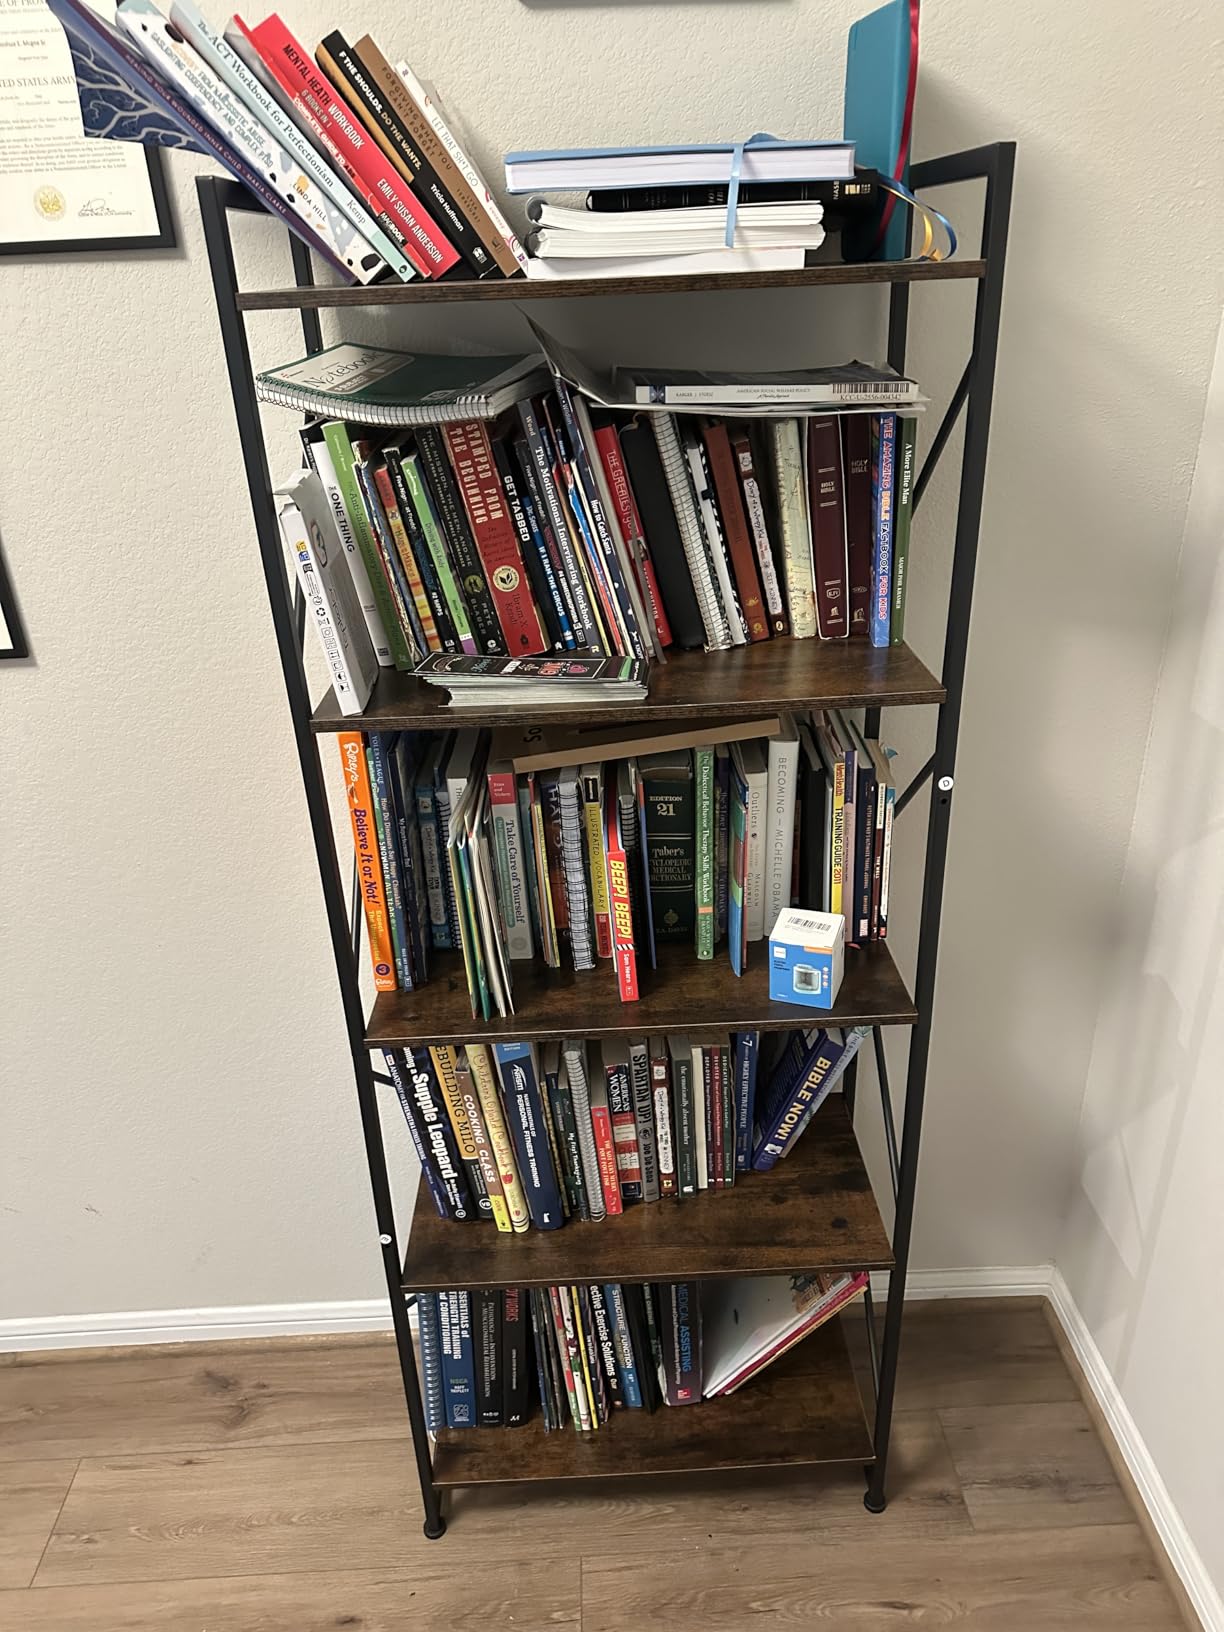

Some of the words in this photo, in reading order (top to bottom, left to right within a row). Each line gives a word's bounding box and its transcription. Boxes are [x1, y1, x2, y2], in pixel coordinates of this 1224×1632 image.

[148, 31, 188, 71] GASLIGHTING
[181, 68, 225, 113] CODEPENDENCY
[222, 112, 236, 126] AND
[232, 123, 261, 152] COMPLEX
[196, 19, 212, 36] The
[206, 32, 234, 62] ACT
[228, 59, 275, 111] Workbook
[268, 108, 286, 127] for
[280, 123, 337, 187] Perfectionism
[280, 43, 313, 80] MENTAL
[305, 76, 333, 106] HEATH
[325, 102, 366, 150] WORKBOOK
[341, 56, 358, 76] THE
[351, 72, 385, 114] SHOULDS.
[378, 110, 392, 126] DO
[387, 123, 404, 142] THE
[397, 139, 424, 171] WANTS.
[379, 65, 420, 121] FORGIVING
[417, 122, 438, 149] WHAT
[436, 150, 453, 171] YOU
[387, 89, 410, 119] CAN'T
[407, 120, 435, 157] FORGET
[170, 99, 204, 133] WOUNDED
[202, 131, 223, 152] INNER
[222, 150, 242, 170] CHILD
[245, 172, 265, 193] MARIA
[264, 191, 287, 215] CLARKE
[430, 116, 445, 133] LET
[440, 130, 458, 152] THAT
[465, 171, 479, 187] GO
[290, 182, 315, 206] LINDA
[310, 204, 329, 222] HILL
[343, 199, 369, 225] Kemp
[375, 178, 399, 204] EMILY
[392, 199, 418, 227] SUSAN
[410, 223, 445, 263] ANDERSON
[428, 183, 446, 204] Tricia
[440, 201, 466, 232] Huffman
[302, 350, 384, 388] Notebook
[883, 416, 893, 438] THE
[448, 426, 467, 453] THE
[458, 459, 488, 524] BEGINNING
[463, 422, 491, 480] STAMPED
[483, 487, 504, 520] FROM
[881, 441, 892, 488] AMAZING
[902, 470, 910, 487] Elite
[425, 430, 436, 449] THE
[431, 449, 449, 491] MISSION,
[445, 493, 455, 512] THE
[450, 511, 462, 533] MEN,
[458, 534, 469, 554] AND
[464, 554, 473, 567] ME
[501, 474, 518, 498] GET
[329, 492, 344, 517] ONE
[337, 518, 356, 553] THING
[508, 498, 533, 542] TABBED
[525, 505, 534, 516] Dr.
[589, 499, 600, 513] How
[594, 512, 602, 521] to
[880, 490, 890, 520] BIBLE
[528, 515, 539, 533] Seuss
[534, 446, 546, 466] The
[540, 467, 563, 527] Motivational
[556, 526, 580, 585] Interviewing
[574, 585, 593, 630] Workbook
[595, 520, 608, 539] Catch
[537, 545, 546, 554] IF
[601, 537, 613, 555] Santa
[879, 522, 889, 572] FACTBOOK
[541, 558, 552, 575] RAN
[546, 574, 557, 590] THE
[551, 589, 565, 617] CIRCUS
[878, 576, 887, 595] FOR
[878, 597, 887, 619] KIDS
[342, 741, 362, 783] Ripley's
[775, 757, 787, 813] BECOMING
[352, 806, 372, 850] Believe
[656, 803, 676, 816] 21
[750, 791, 760, 828] Outliers
[833, 807, 843, 844] TRAINING
[504, 820, 516, 846] Take
[588, 805, 601, 855] ILLUSTRATED
[700, 830, 708, 854] Therapy
[360, 851, 374, 864] It
[378, 841, 390, 879] SNOWMEN
[384, 881, 392, 895] ALL
[507, 846, 519, 870] Care
[652, 846, 684, 858] Taber's
[772, 829, 783, 877] MICHELLE
[833, 844, 842, 867] GUIDE
[363, 864, 374, 878] or
[510, 871, 520, 881] of
[592, 860, 606, 909] VOCABULARY
[608, 858, 628, 897] BEEP!
[833, 868, 842, 884] 2011
[364, 880, 382, 905] Not!
[511, 883, 525, 924] Yourself
[770, 883, 780, 918] OBAMA
[613, 900, 632, 940] BEEP!
[623, 964, 632, 983] Hearn
[512, 1067, 524, 1091] NASM
[632, 1054, 650, 1102] SPARTAN
[679, 1065, 687, 1075] the
[795, 1055, 831, 1103] BIBLE
[407, 1071, 442, 1124] Supple
[609, 1074, 622, 1112] WOMEN
[679, 1075, 688, 1107] emotionally
[637, 1105, 651, 1123] UP!
[681, 1108, 689, 1125] absent
[773, 1100, 805, 1142] NOW!
[423, 1121, 460, 1181] Leopard
[460, 1093, 487, 1144] COOKING
[476, 1148, 497, 1184] CLASS
[515, 1094, 529, 1129] PERSONAL
[522, 1130, 534, 1157] FITNESS
[528, 1158, 540, 1188] TRAINING
[642, 1143, 651, 1155] Joe
[682, 1125, 690, 1145] mother
[567, 1132, 574, 1140] My
[571, 1154, 581, 1185] Thanksgiving
[643, 1155, 651, 1165] De
[644, 1166, 652, 1183] Sena
[677, 1285, 688, 1323] MEDICAL
[451, 1325, 461, 1359] TRAINING
[594, 1309, 610, 1341] Exercise
[611, 1288, 626, 1331] STRUCTURE
[620, 1334, 632, 1368] FUNCTION
[600, 1341, 617, 1376] Solutions
[679, 1325, 691, 1372] ASSISTING
